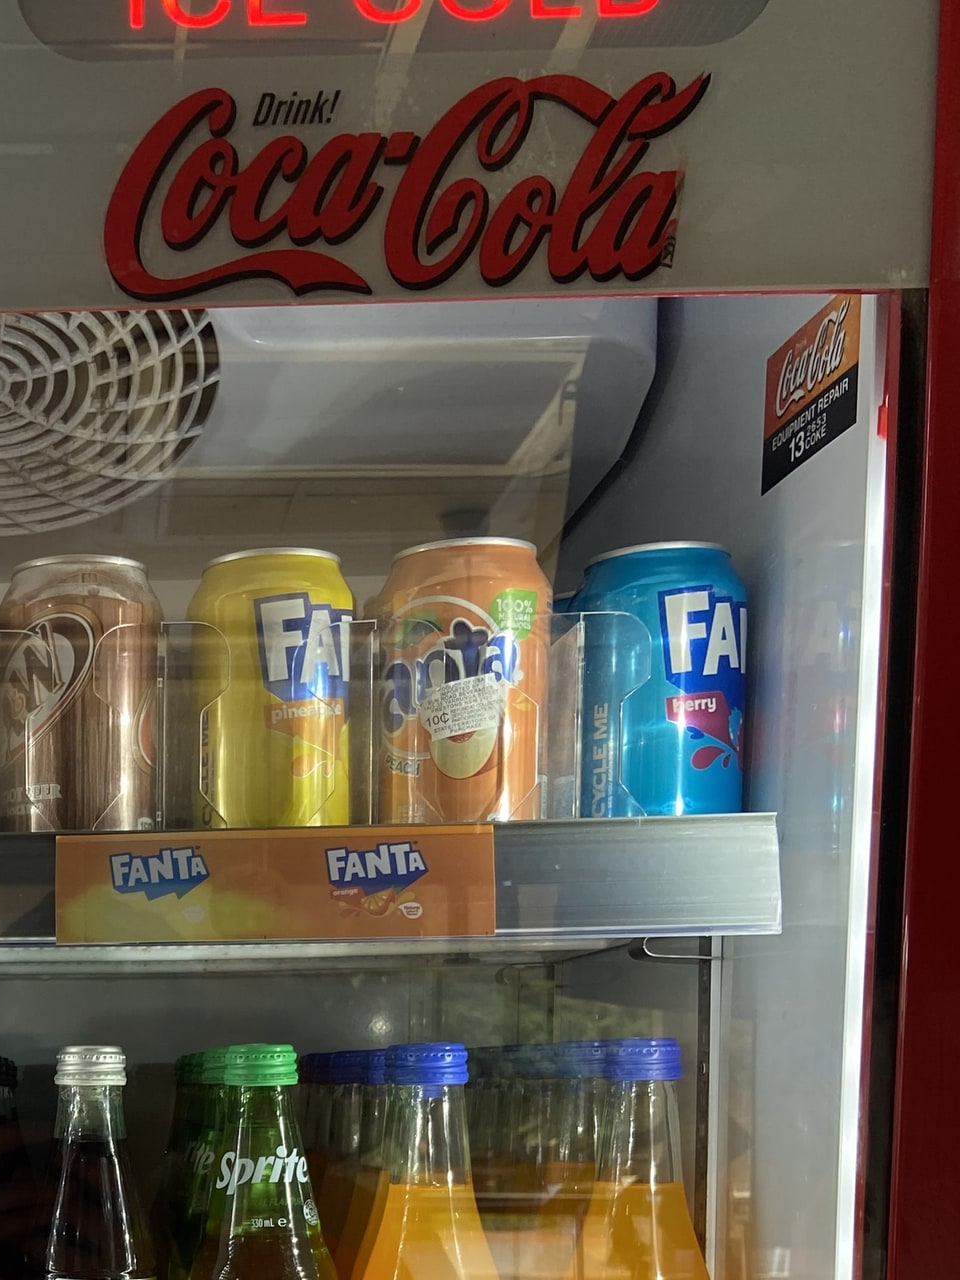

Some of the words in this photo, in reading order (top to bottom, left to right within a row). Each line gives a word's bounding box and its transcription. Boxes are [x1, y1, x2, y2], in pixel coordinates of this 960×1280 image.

[251, 88, 342, 126] Drink!
[103, 71, 712, 300] Coca-Cola
[776, 296, 852, 418] Coca-Cola
[772, 404, 816, 451] EQUIPMENT
[818, 377, 849, 410] REPAIR
[789, 431, 805, 462] 13
[806, 412, 827, 435] 2653
[805, 424, 827, 450] COKE
[496, 598, 534, 614] 100%
[271, 703, 342, 724] pineapple
[426, 712, 449, 727] 10¢
[594, 703, 608, 739] ME
[672, 697, 716, 714] berry
[385, 752, 421, 778] PEACH
[26, 783, 62, 802] BEER
[112, 848, 206, 887] FANTA
[328, 843, 425, 880] FANTA
[333, 888, 358, 896] orange
[216, 1146, 310, 1195] Sprite
[251, 1218, 263, 1228] 330
[264, 1218, 275, 1227] mL
